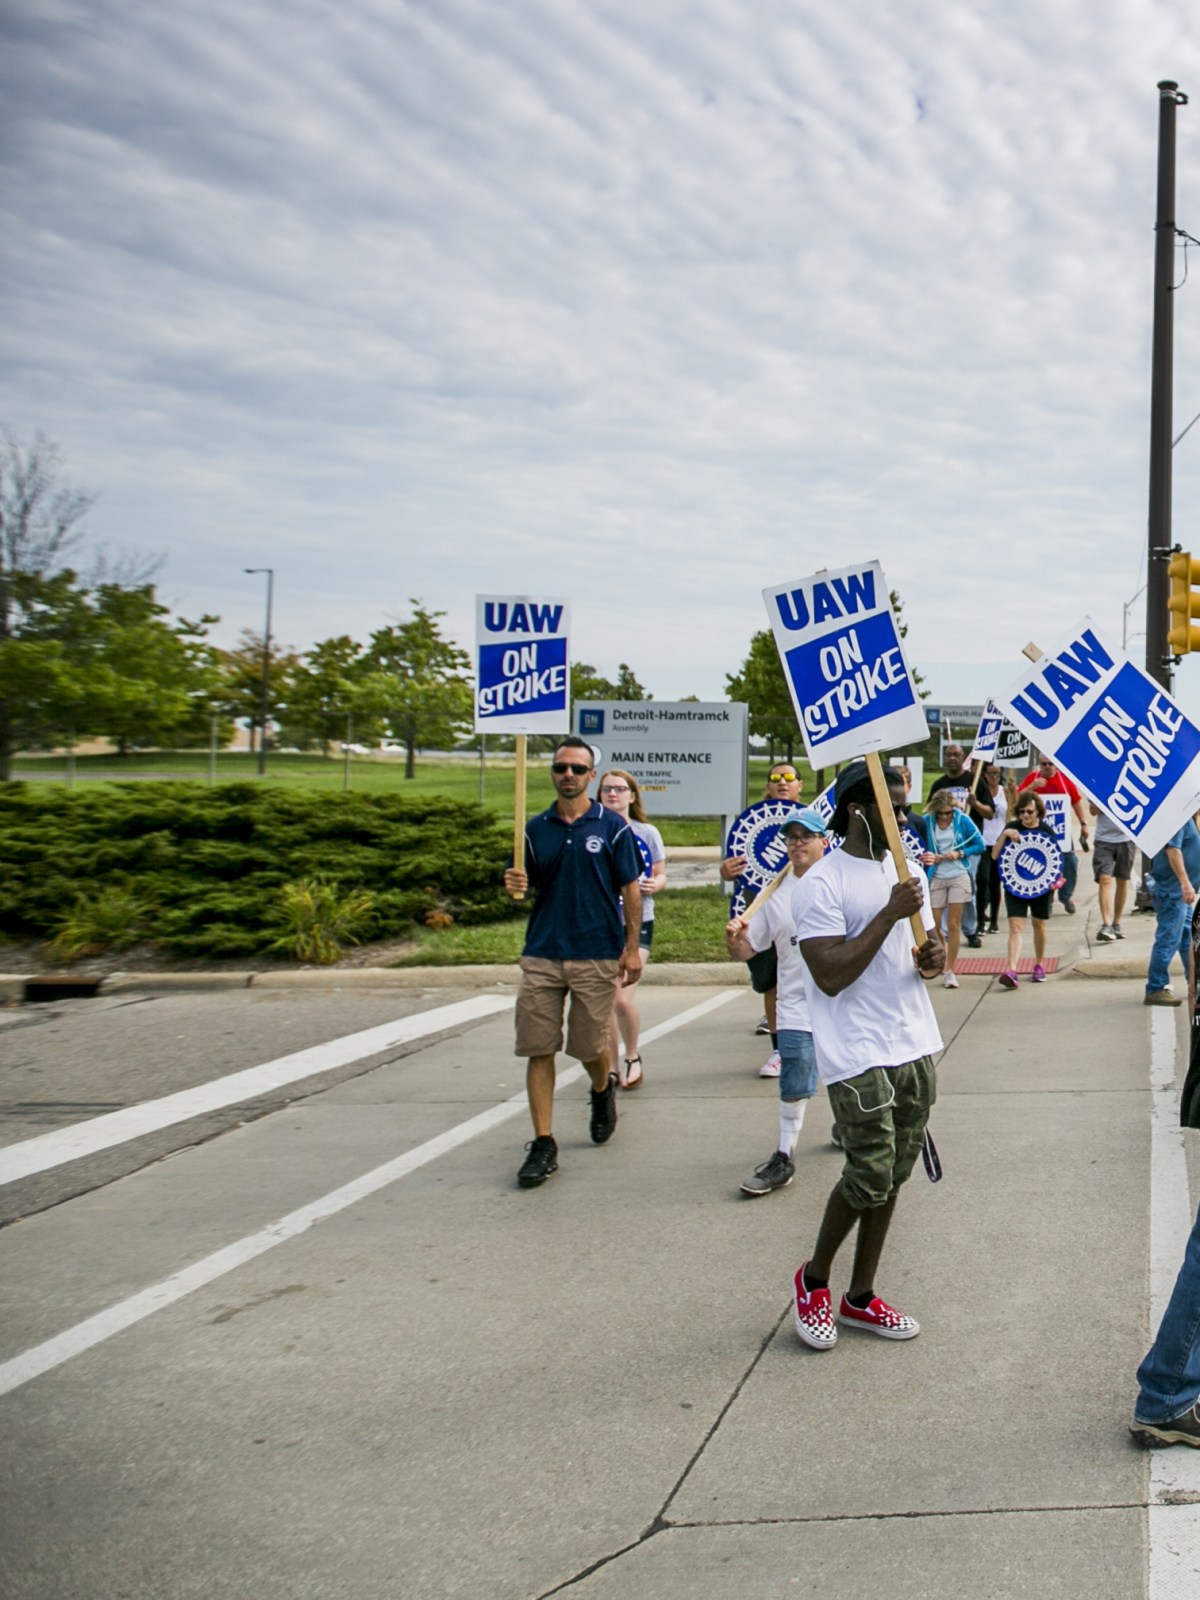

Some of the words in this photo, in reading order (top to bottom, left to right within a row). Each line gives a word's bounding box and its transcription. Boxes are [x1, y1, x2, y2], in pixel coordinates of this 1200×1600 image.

[775, 570, 876, 631] UAW
[484, 602, 564, 633] UAW
[502, 643, 537, 677] ON
[819, 629, 863, 682] ON
[479, 665, 566, 715] STRIKE
[1010, 628, 1115, 730] UAW
[804, 647, 907, 742] STRIKE
[584, 714, 599, 726] GM
[612, 709, 730, 721] Detroit-Hamtramck
[612, 724, 649, 734] Assembly
[985, 721, 998, 734] ON
[1007, 733, 1022, 744] ON
[1087, 695, 1136, 762] ON
[975, 731, 1000, 749] STRIKE
[996, 739, 1030, 758] STRIKE
[611, 752, 645, 763] MAIN
[647, 752, 712, 764] ENTRANCE
[1108, 692, 1184, 831] STRIKE
[645, 770, 672, 778] TRAFFIC
[1045, 800, 1064, 811] AW
[761, 831, 788, 868] AW
[1017, 852, 1045, 876] UAW
